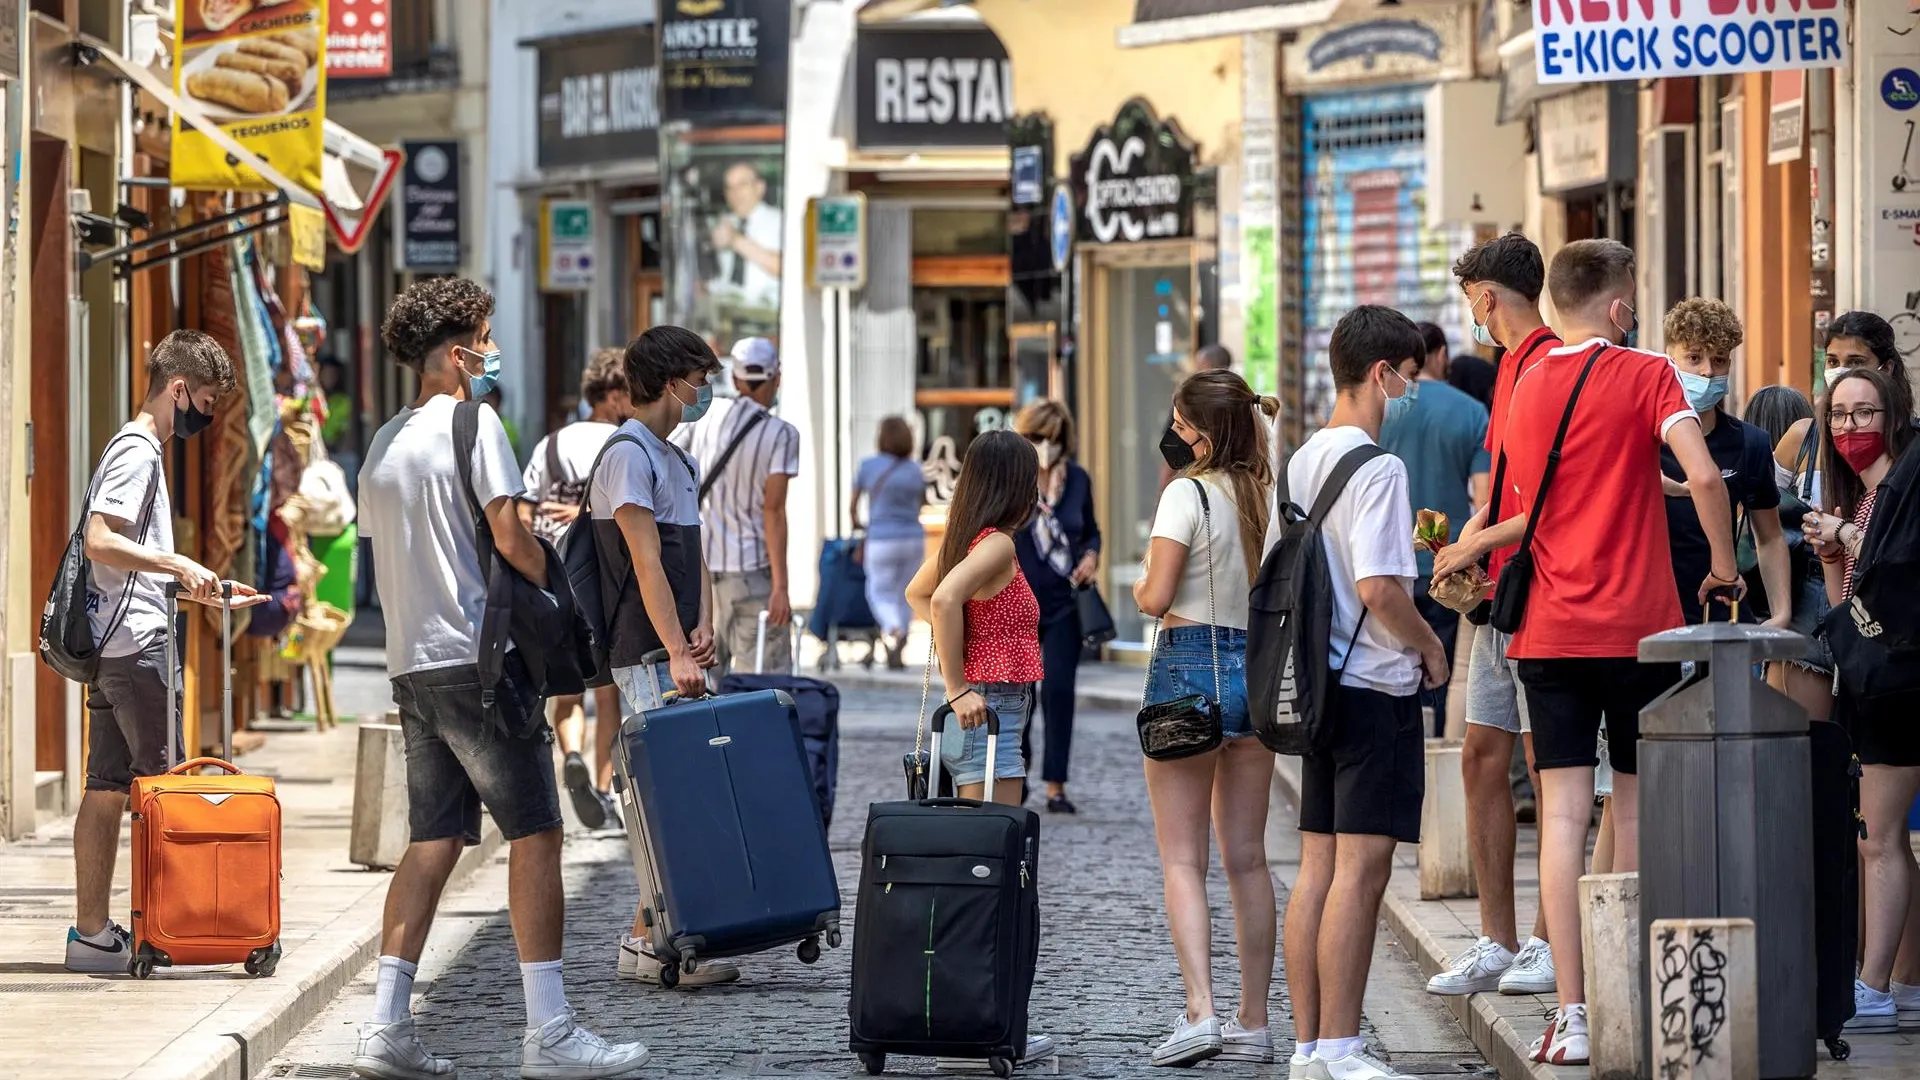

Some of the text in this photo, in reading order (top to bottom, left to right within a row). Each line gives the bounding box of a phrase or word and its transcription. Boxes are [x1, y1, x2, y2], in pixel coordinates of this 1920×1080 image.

[240, 12, 312, 33] CACHITOS
[663, 19, 757, 49] AMSTEL
[1542, 17, 1842, 75] E-KICK SCOOTER
